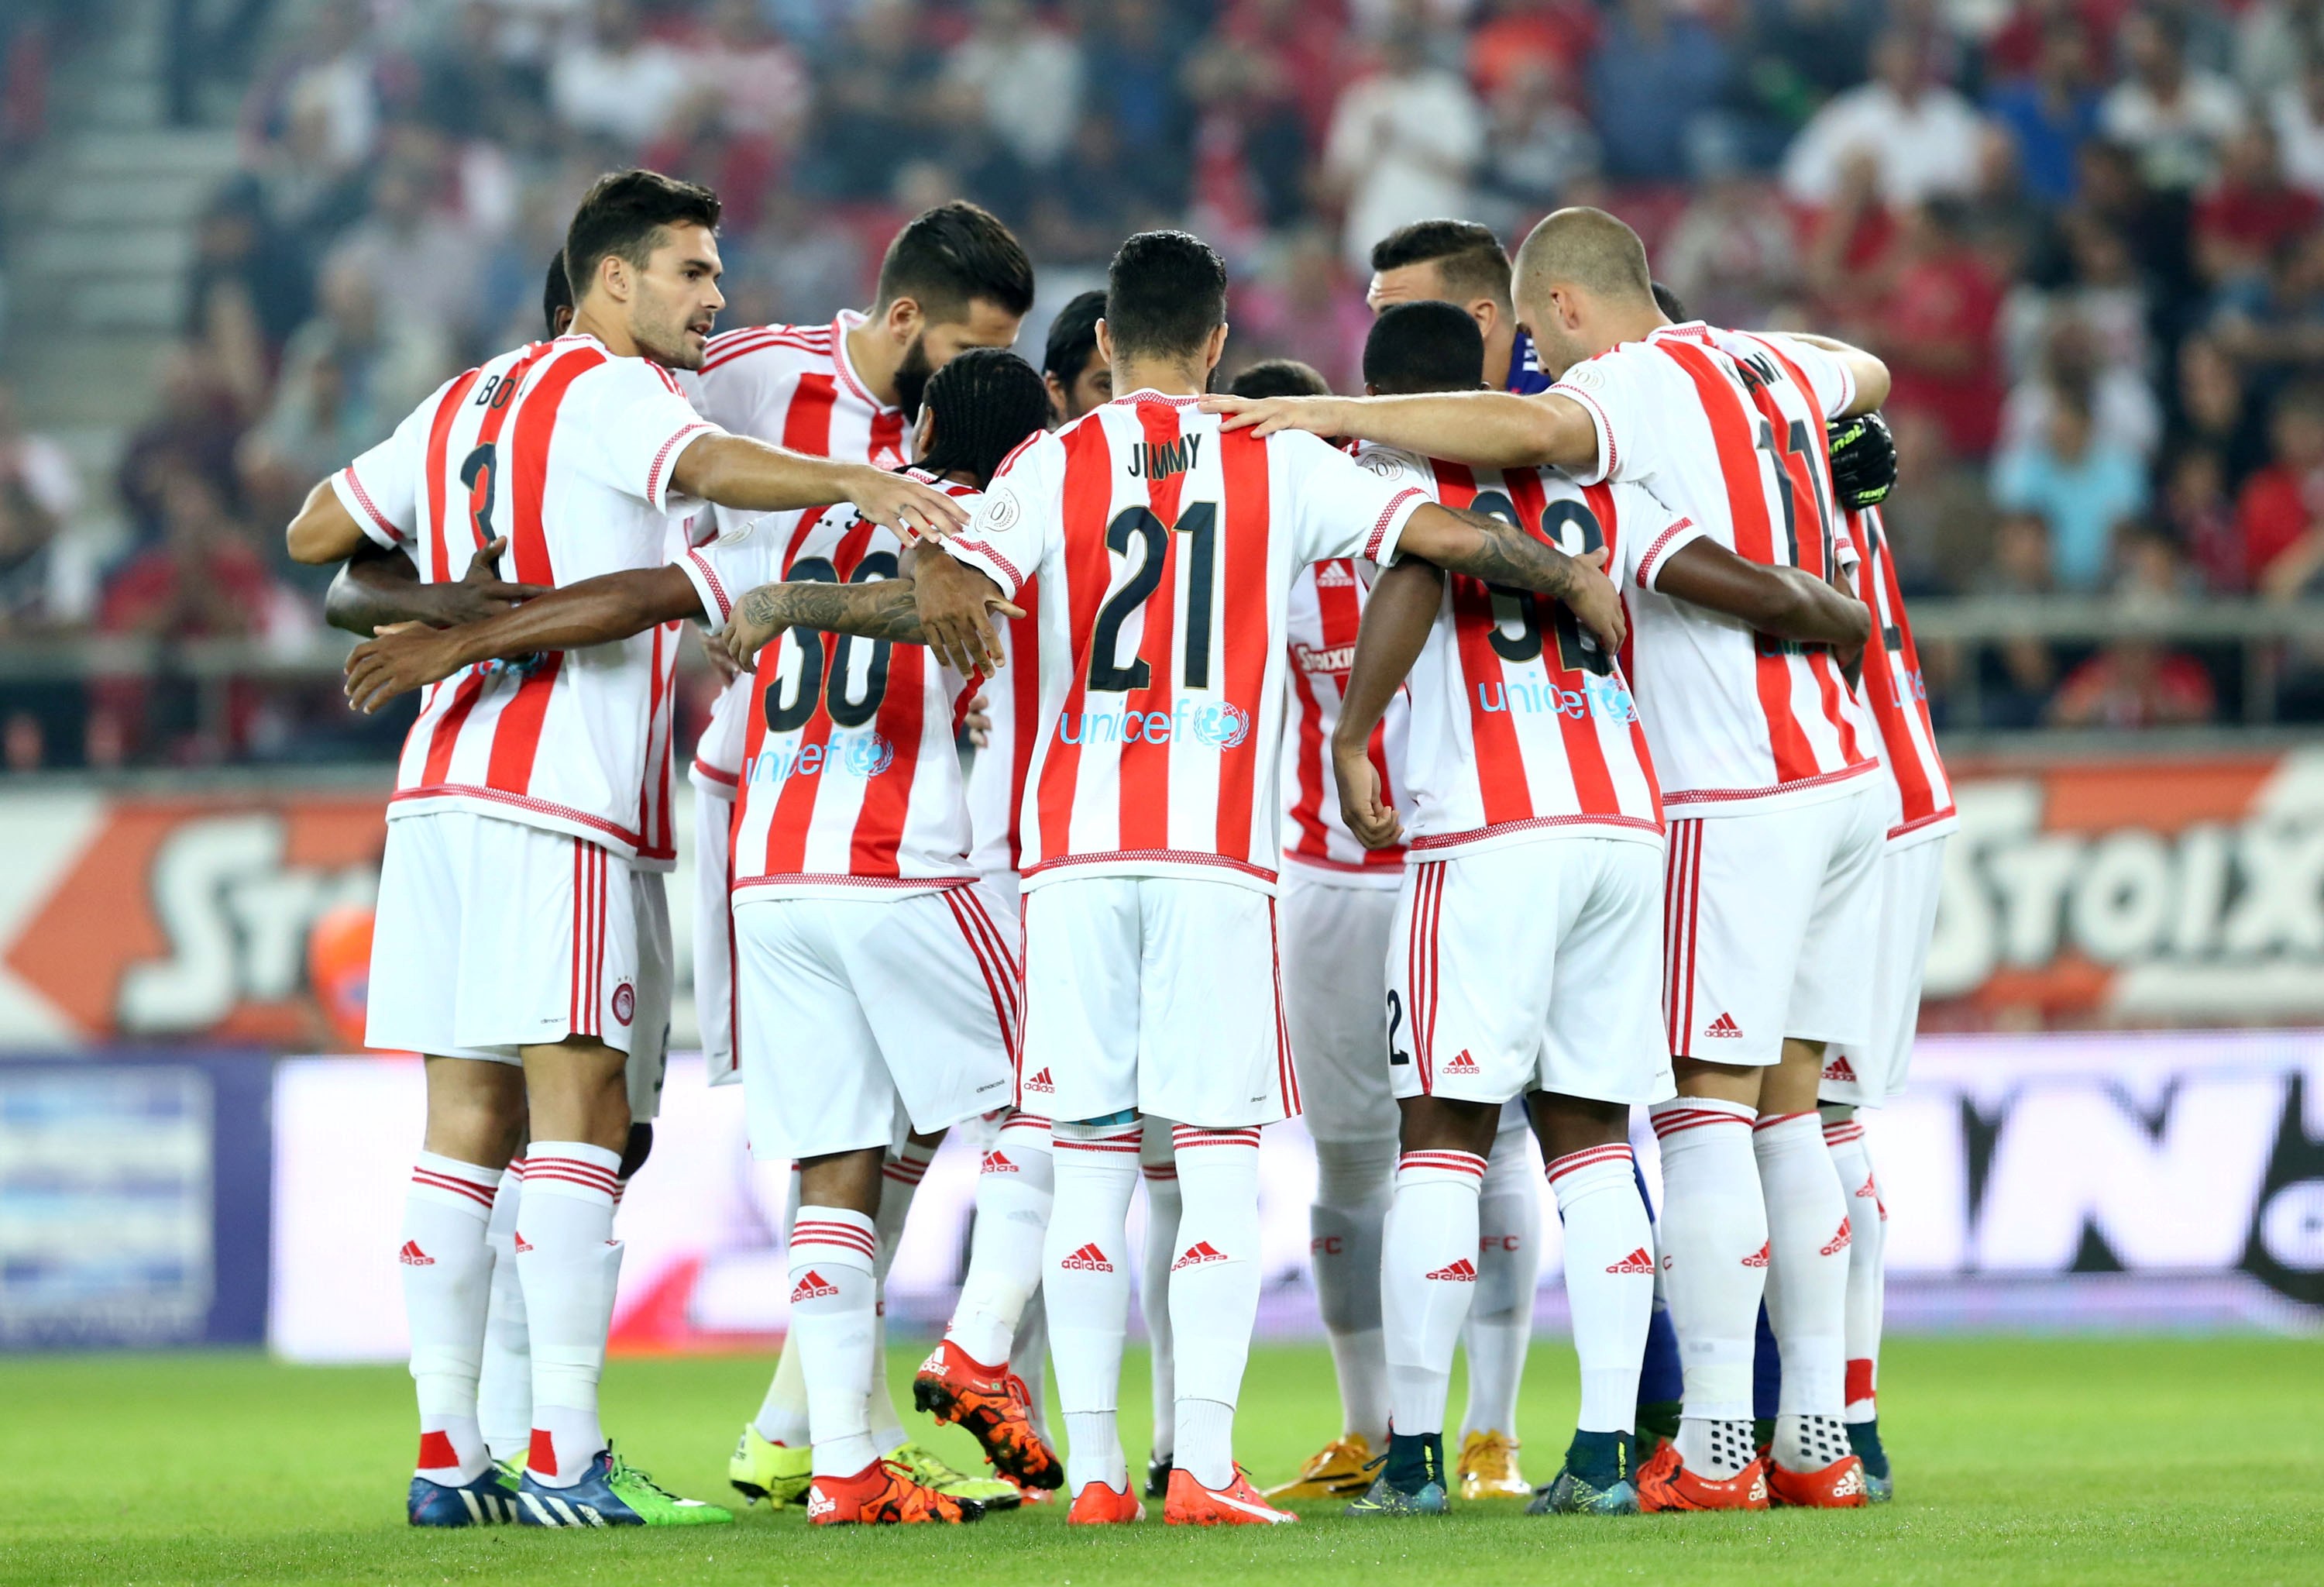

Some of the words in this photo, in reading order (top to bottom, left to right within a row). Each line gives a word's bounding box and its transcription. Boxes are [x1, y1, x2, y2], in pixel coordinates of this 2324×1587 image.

[1127, 432, 1202, 480] JIMMY
[1756, 418, 1833, 587] 11
[1087, 500, 1219, 692] 21
[1479, 672, 1598, 721] unicef
[1059, 698, 1190, 745] unicef
[1704, 1029, 1744, 1038] adidas
[1023, 1082, 1056, 1094] adidas
[1442, 1065, 1480, 1074] adidas
[1061, 1250, 1114, 1272] adidas
